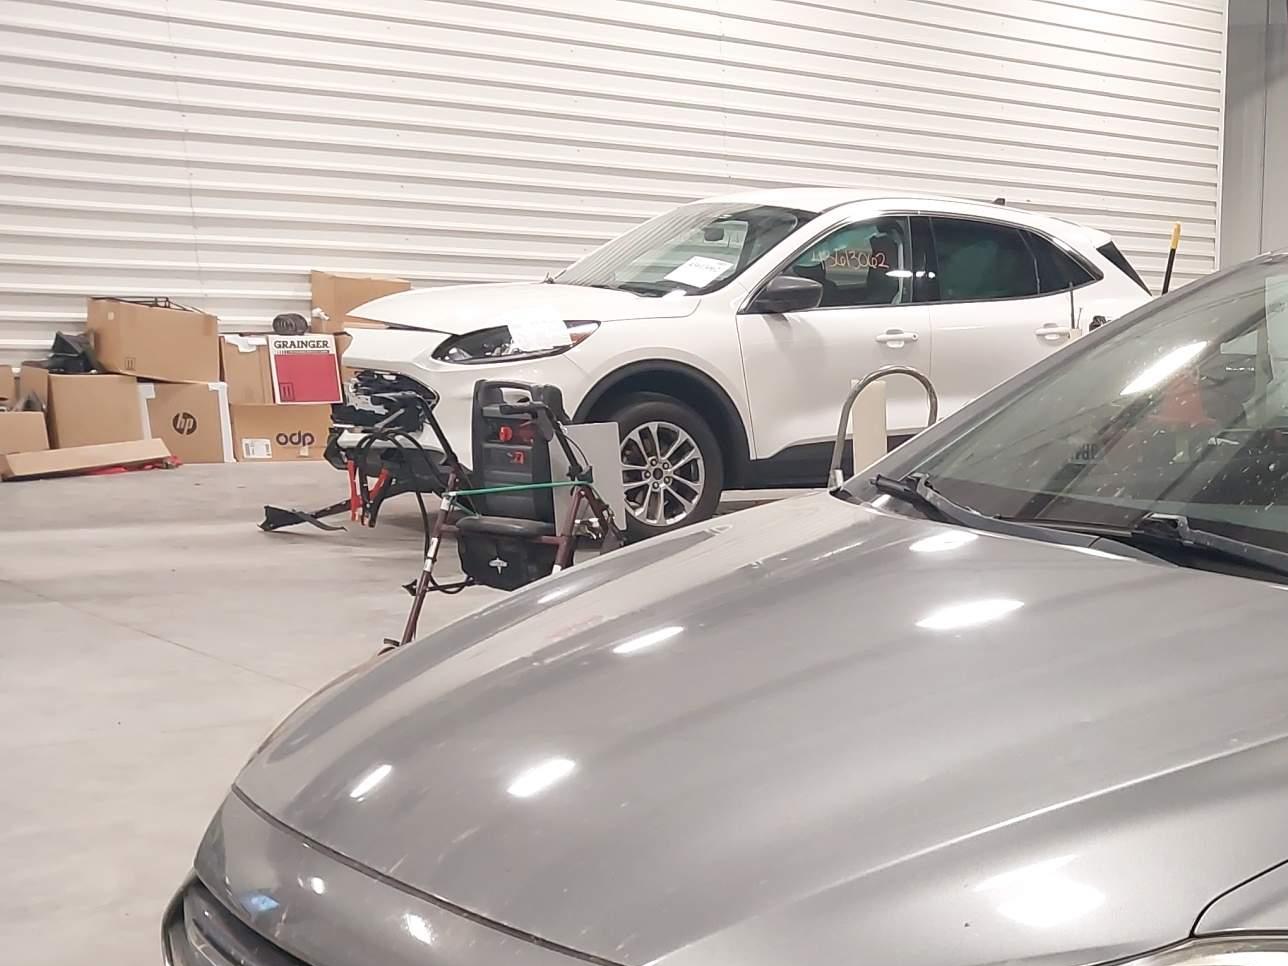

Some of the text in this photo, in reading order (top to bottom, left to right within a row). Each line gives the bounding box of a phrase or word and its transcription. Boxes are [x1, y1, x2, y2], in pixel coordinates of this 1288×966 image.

[274, 340, 329, 349] GRAINGER
[174, 412, 196, 435] hp
[275, 430, 315, 447] odp
